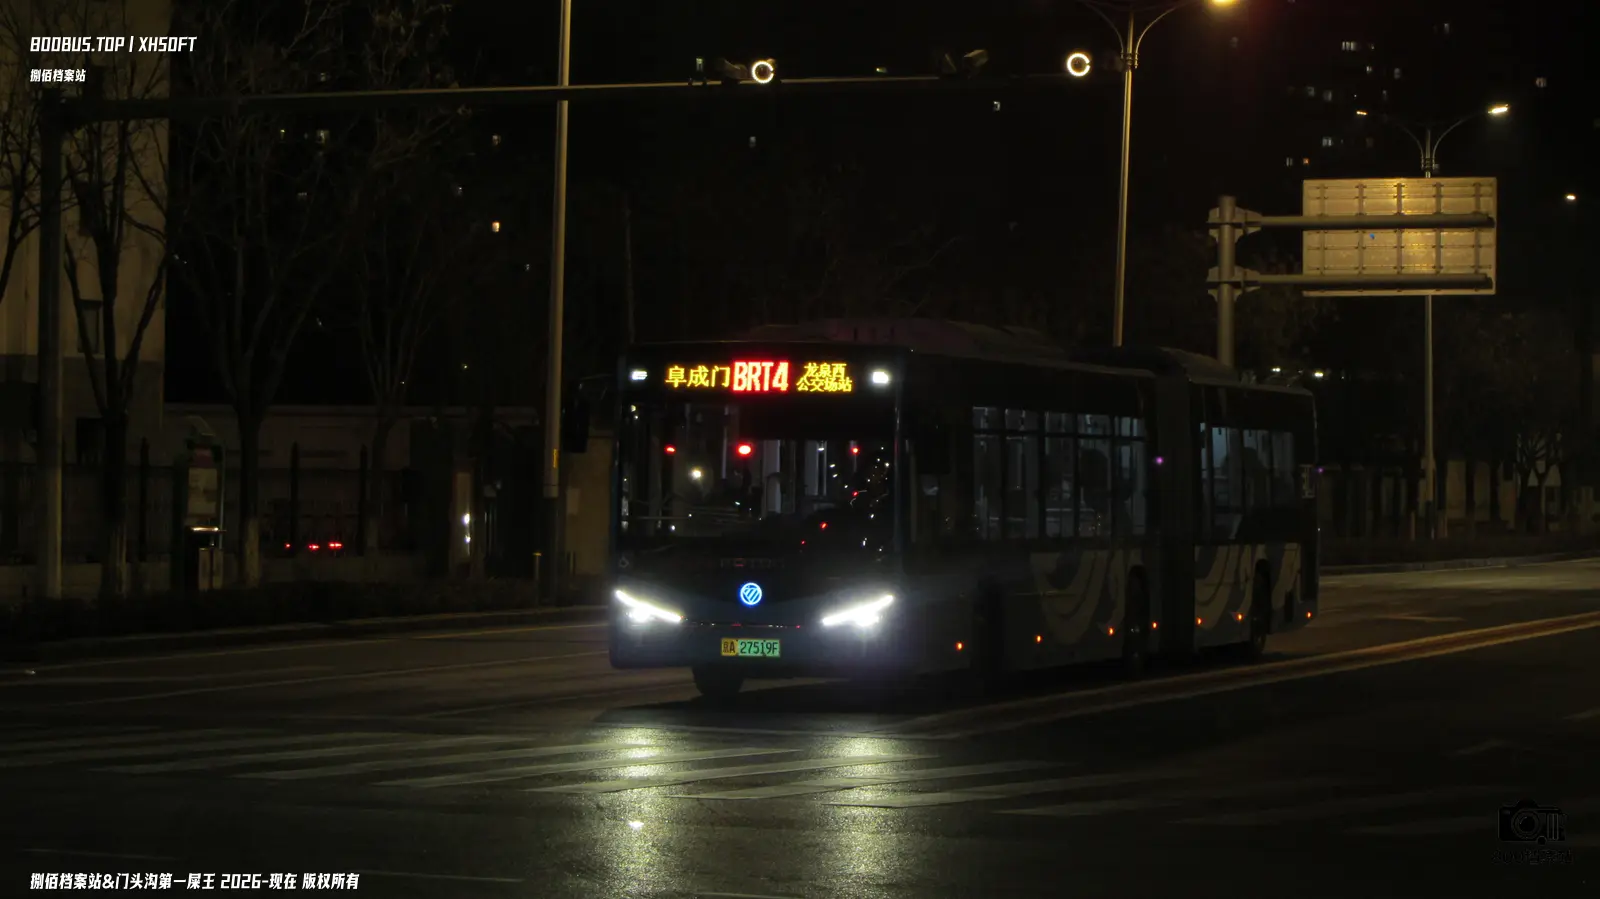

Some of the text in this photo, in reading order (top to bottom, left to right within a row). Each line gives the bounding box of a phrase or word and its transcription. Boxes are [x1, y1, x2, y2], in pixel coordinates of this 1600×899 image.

[665, 361, 789, 391] 阜成门 BRT4
[804, 362, 847, 379] 龙泉西
[796, 377, 853, 392] 公交场站
